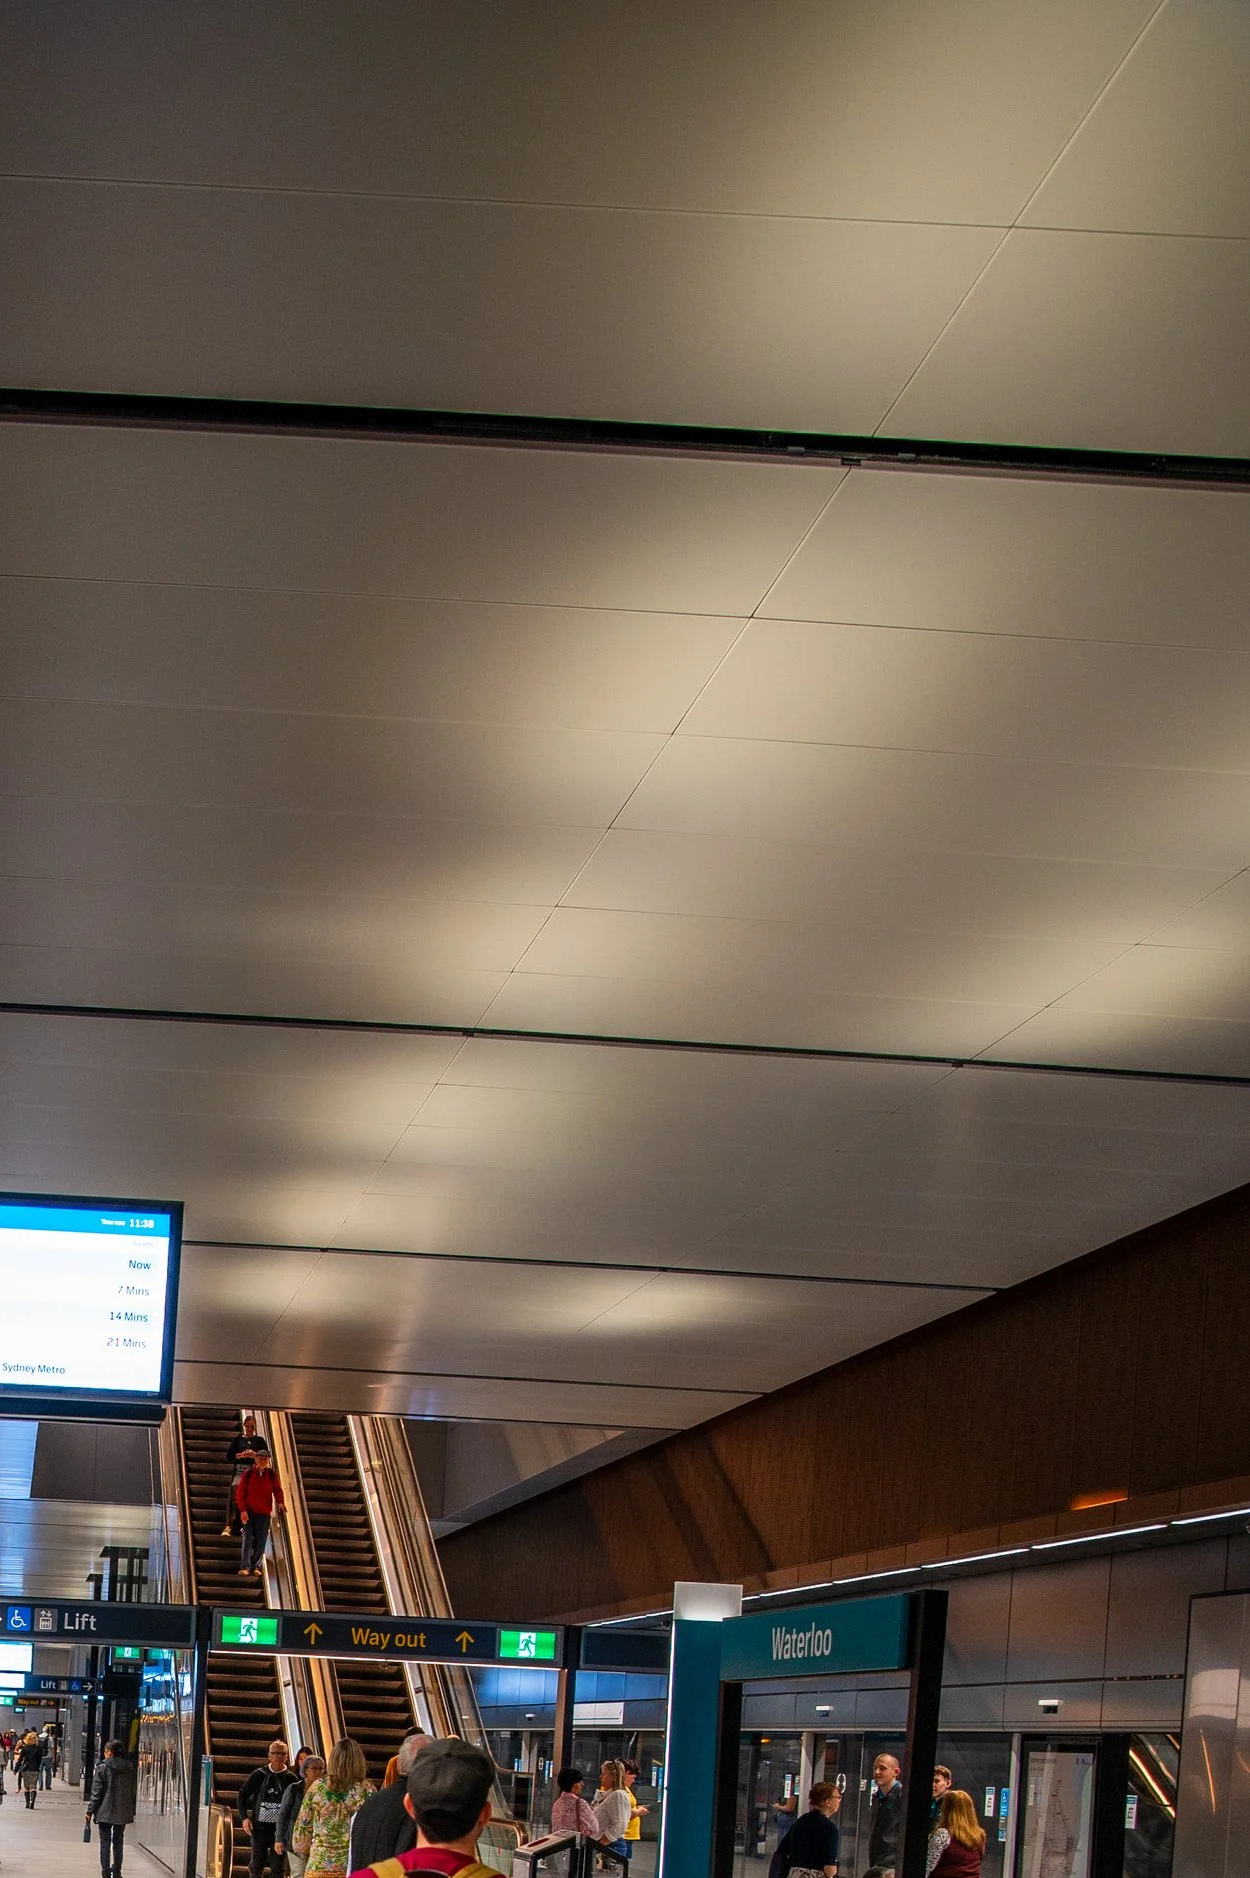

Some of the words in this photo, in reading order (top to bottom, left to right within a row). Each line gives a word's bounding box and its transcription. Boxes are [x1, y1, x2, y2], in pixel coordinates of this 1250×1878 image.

[129, 1218, 155, 1229] 11:38
[129, 1259, 152, 1270] Now
[118, 1285, 123, 1295] 7
[125, 1285, 150, 1297] Mins
[110, 1311, 122, 1321] 14
[124, 1312, 148, 1323] Mins
[106, 1337, 119, 1347] 21
[123, 1338, 147, 1349] Mins
[2, 1362, 36, 1375] Sydney
[37, 1364, 66, 1375] Metro
[63, 1612, 97, 1631] Lift
[351, 1627, 392, 1650] Way
[395, 1631, 427, 1648] out
[772, 1622, 832, 1661] Waterloo
[40, 1680, 56, 1690] Lift
